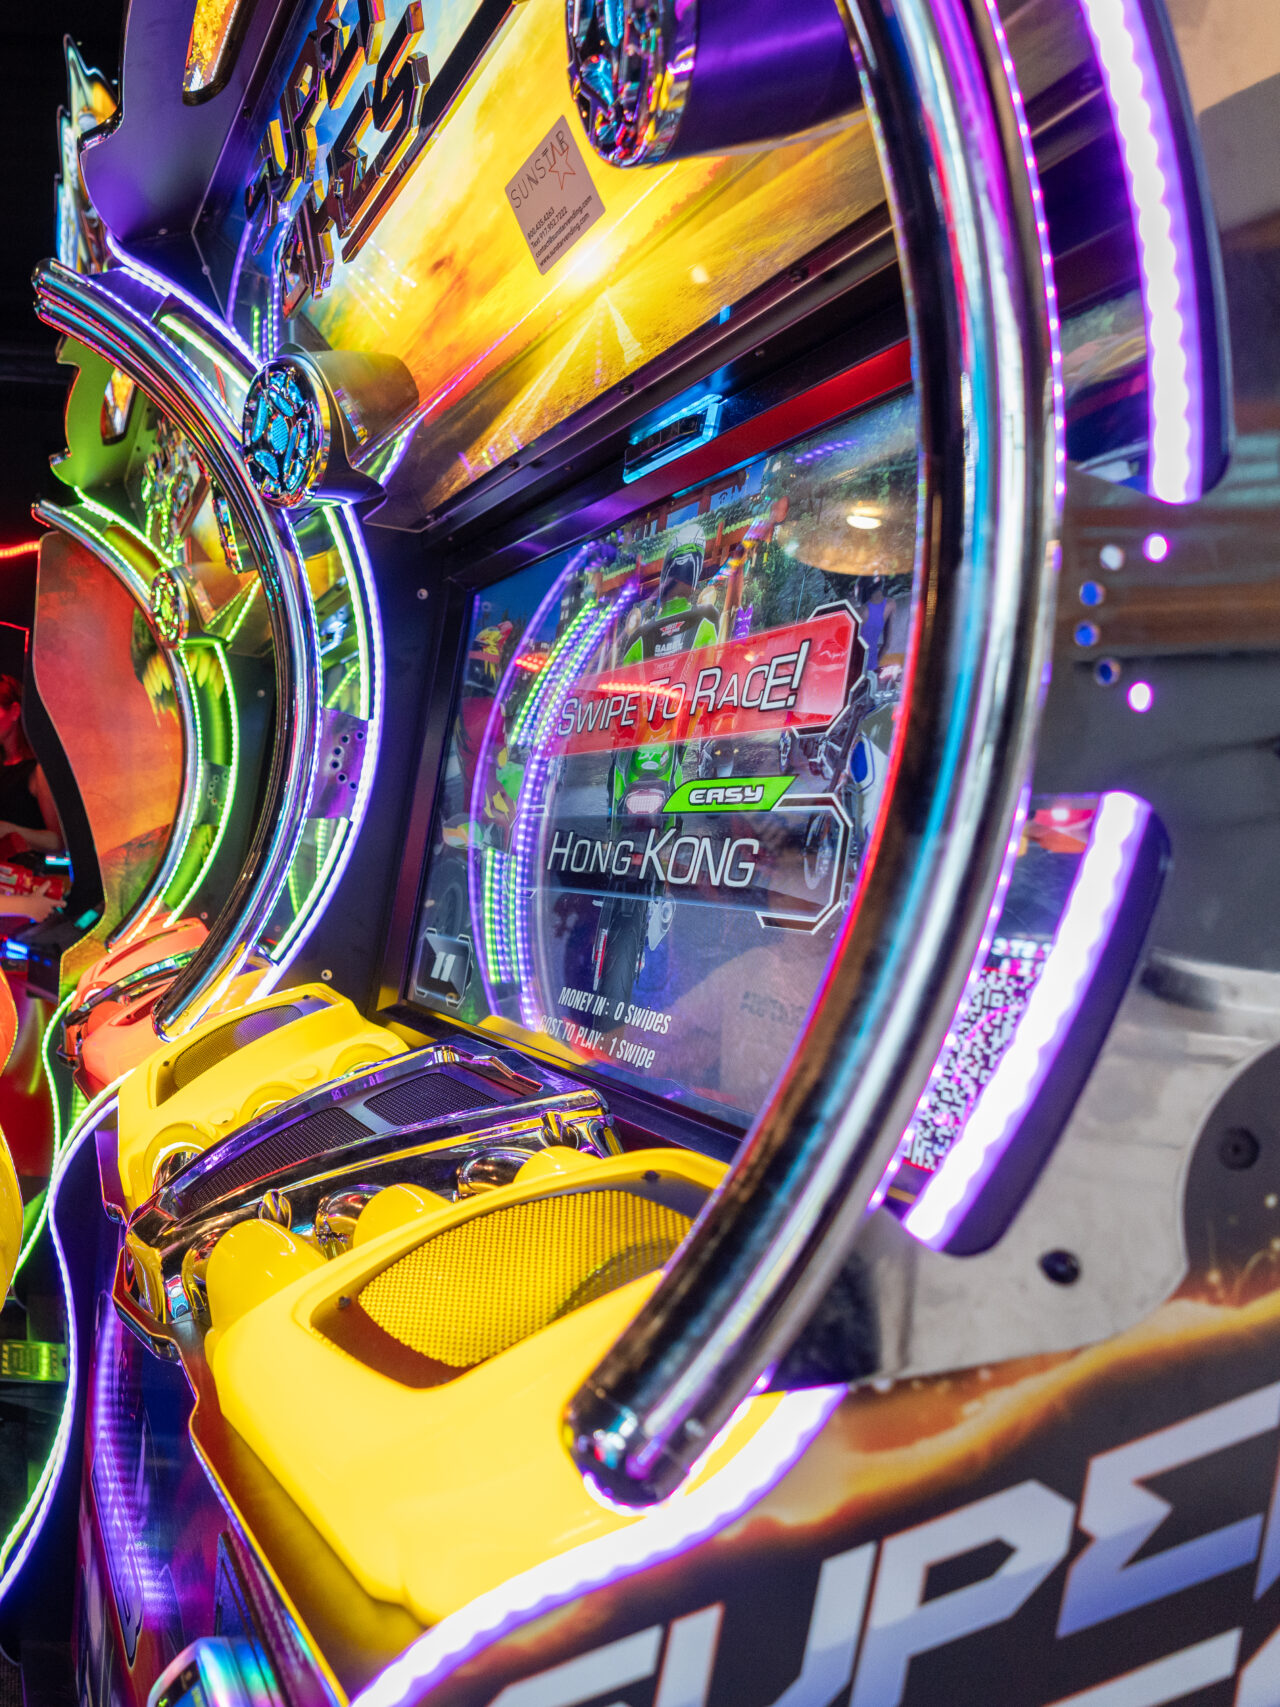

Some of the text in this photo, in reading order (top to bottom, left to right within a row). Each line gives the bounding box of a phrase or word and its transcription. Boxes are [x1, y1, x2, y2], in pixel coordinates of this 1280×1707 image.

[510, 130, 569, 208] SUNSTAR
[689, 784, 765, 806] EASY
[558, 986, 595, 1013] MONEY
[592, 995, 610, 1016] IN:
[614, 1001, 624, 1021] 0
[540, 1014, 563, 1038] COST
[562, 1021, 575, 1041] TO
[574, 1025, 605, 1050] PLAY:
[608, 1037, 617, 1056] 1
